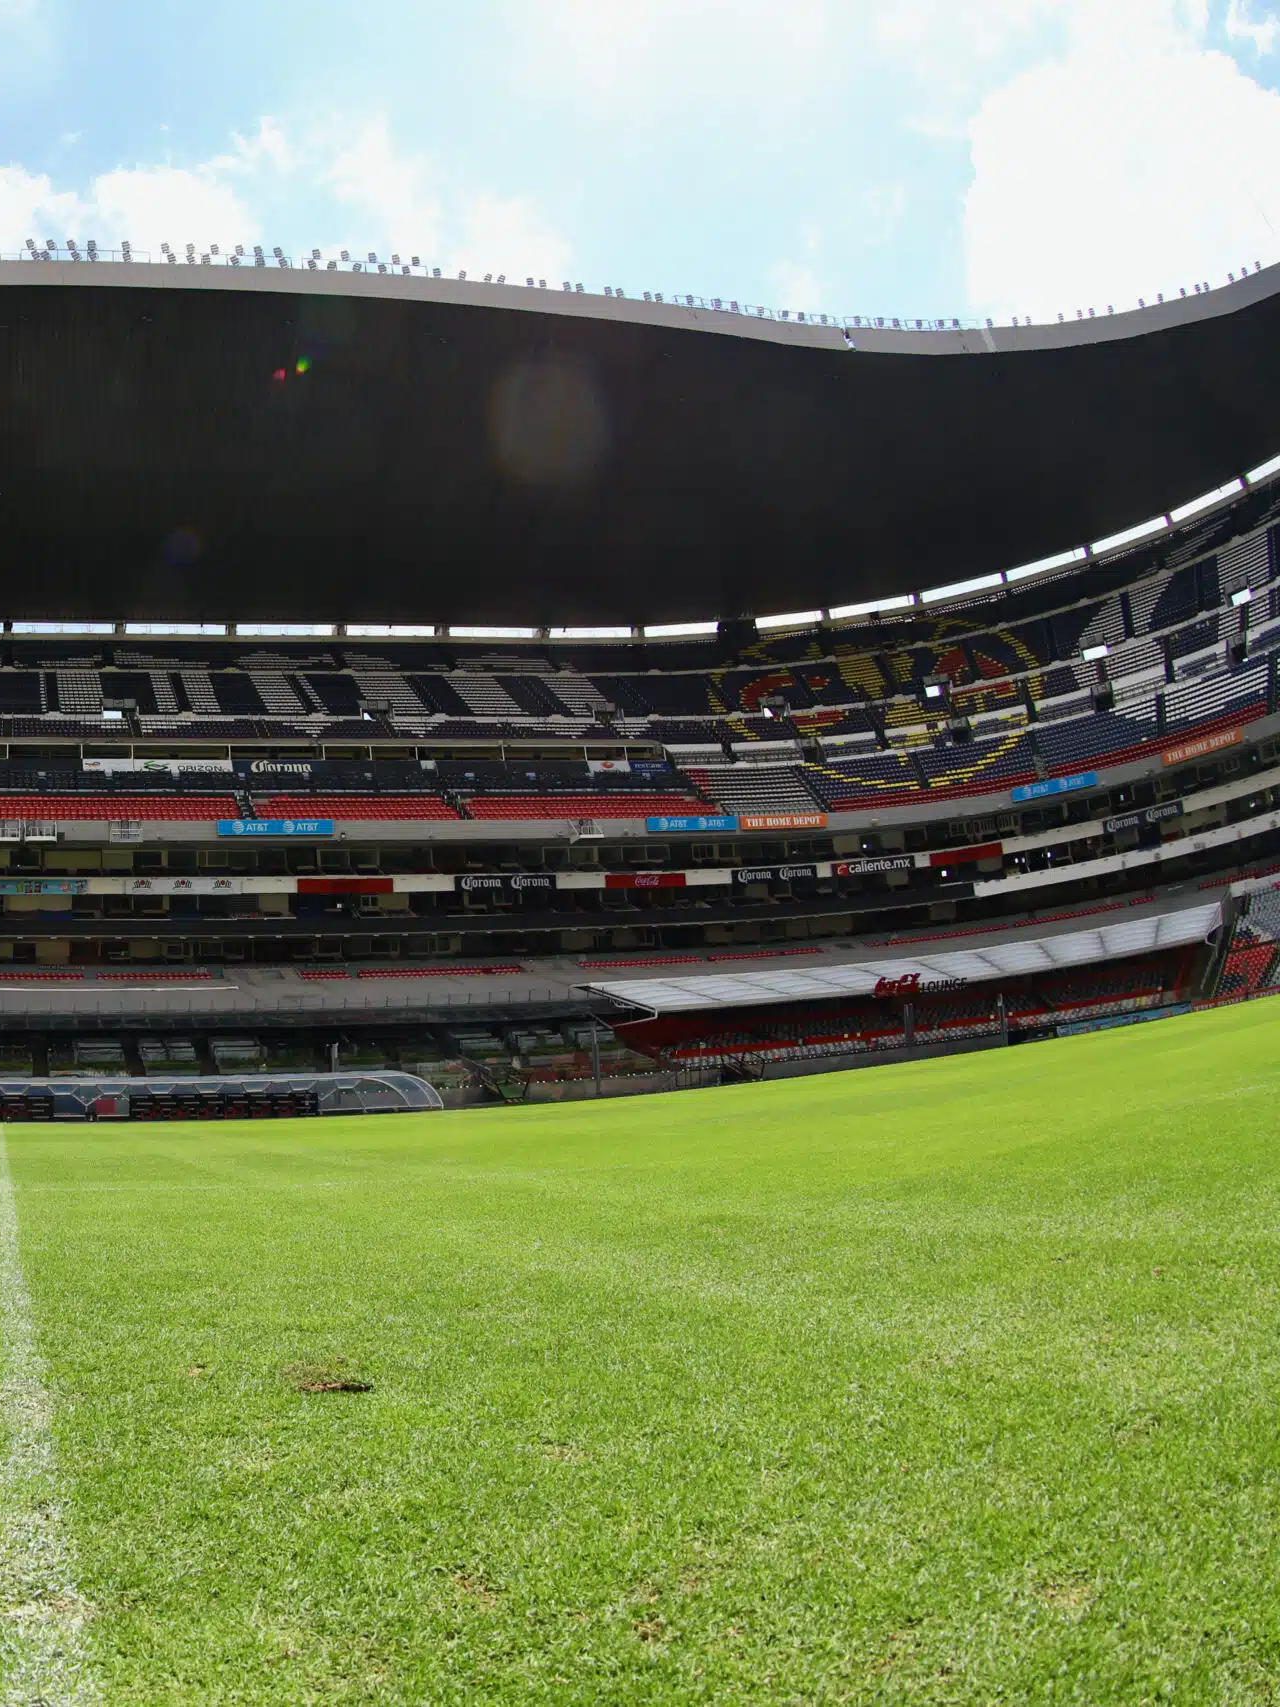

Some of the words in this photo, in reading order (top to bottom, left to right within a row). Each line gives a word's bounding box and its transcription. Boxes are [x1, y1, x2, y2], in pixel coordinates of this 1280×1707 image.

[1167, 749, 1184, 762] THE
[1184, 741, 1209, 756] HOME
[1209, 731, 1236, 748] DEPOT
[251, 760, 312, 774] Corona
[1032, 784, 1049, 794] AT&T
[745, 818, 765, 828] THE
[766, 817, 792, 827] HOME
[793, 815, 822, 825] DEPOT
[1145, 805, 1178, 823] Corona
[245, 822, 269, 832] AT&T
[296, 822, 319, 832] AT&T
[669, 819, 688, 828] AT&T
[707, 819, 726, 828] AT&T
[1106, 816, 1140, 832] Corona
[848, 855, 911, 874] caliente.mx
[737, 868, 773, 883] Corona
[778, 865, 813, 881] Corona
[461, 875, 503, 890] Corona
[510, 875, 552, 890] Corona
[921, 977, 968, 993] LOUNGE
